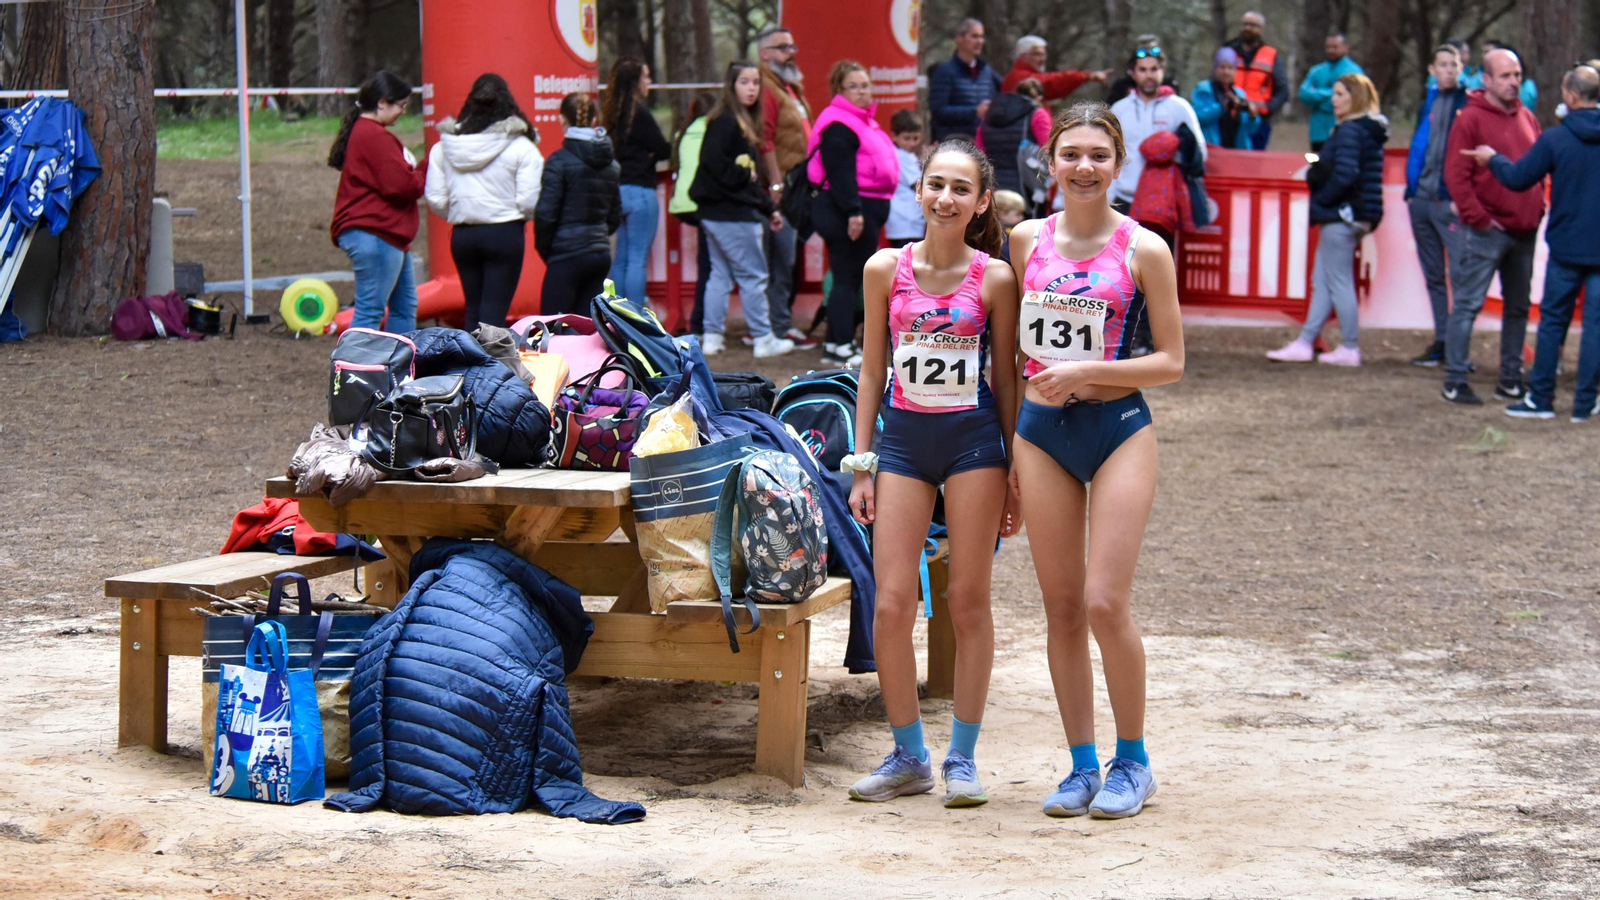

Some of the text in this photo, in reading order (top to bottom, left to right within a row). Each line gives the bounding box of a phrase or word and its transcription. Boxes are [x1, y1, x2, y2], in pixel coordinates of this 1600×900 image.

[1045, 273, 1076, 293] IRAS
[1042, 303, 1068, 312] PINAR
[1069, 307, 1084, 315] DEL
[911, 309, 938, 333] CIRAS
[1028, 317, 1092, 351] 131
[916, 342, 941, 350] PINAR
[959, 343, 977, 351] REY
[902, 356, 966, 386] 121
